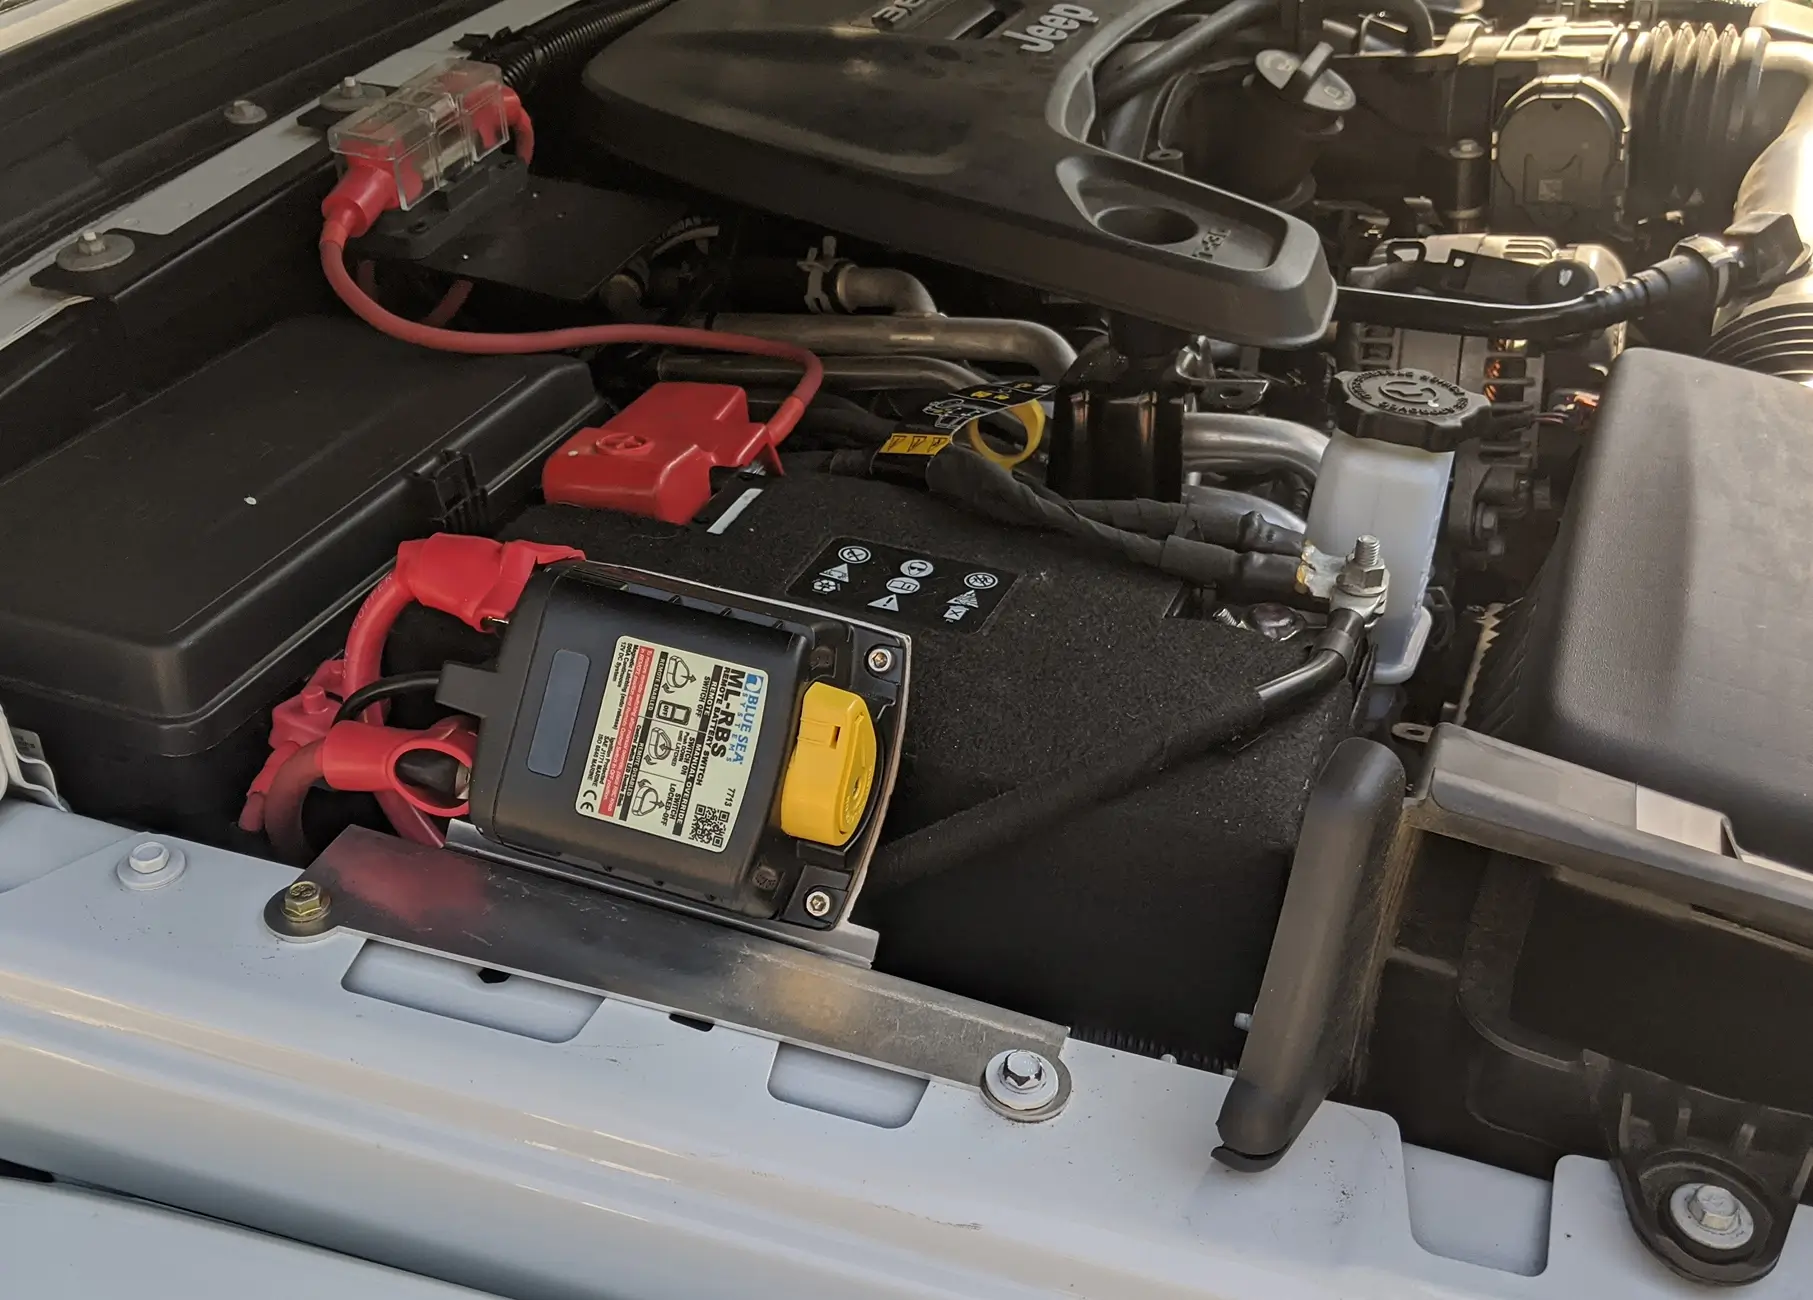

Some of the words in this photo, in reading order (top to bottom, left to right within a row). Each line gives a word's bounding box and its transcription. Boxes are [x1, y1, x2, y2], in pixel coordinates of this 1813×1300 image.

[1003, 3, 1099, 53] Jeep
[617, 652, 623, 660] DC
[654, 658, 665, 682] REMOTE
[647, 683, 658, 710] ENABLED
[698, 675, 710, 702] SWITCH
[703, 680, 717, 716] REMOTE
[715, 666, 730, 704] REMOTE
[661, 704, 669, 716] OFF
[694, 704, 703, 718] OFF
[710, 668, 745, 759] ML-RBS
[739, 693, 758, 733] BLUE
[705, 707, 720, 747] BATTERY
[726, 692, 747, 761] SYSTEMS
[598, 748, 606, 763] J1171
[633, 742, 644, 766] REMOTE
[670, 742, 680, 766] LATCHED
[677, 744, 685, 762] DOWN
[683, 736, 695, 763] SWITCH
[687, 743, 701, 779] MANUAL
[732, 734, 748, 763] SEA
[587, 758, 597, 781] MARINE
[592, 764, 601, 786] MARINE
[680, 764, 687, 775] ON
[695, 750, 709, 785] SWITCH
[626, 767, 637, 796] DISABLED
[660, 782, 676, 826] LOCKED-OFF
[669, 792, 681, 820] SWITCH
[676, 781, 691, 824] OVERRIDE
[723, 787, 735, 807] 7713
